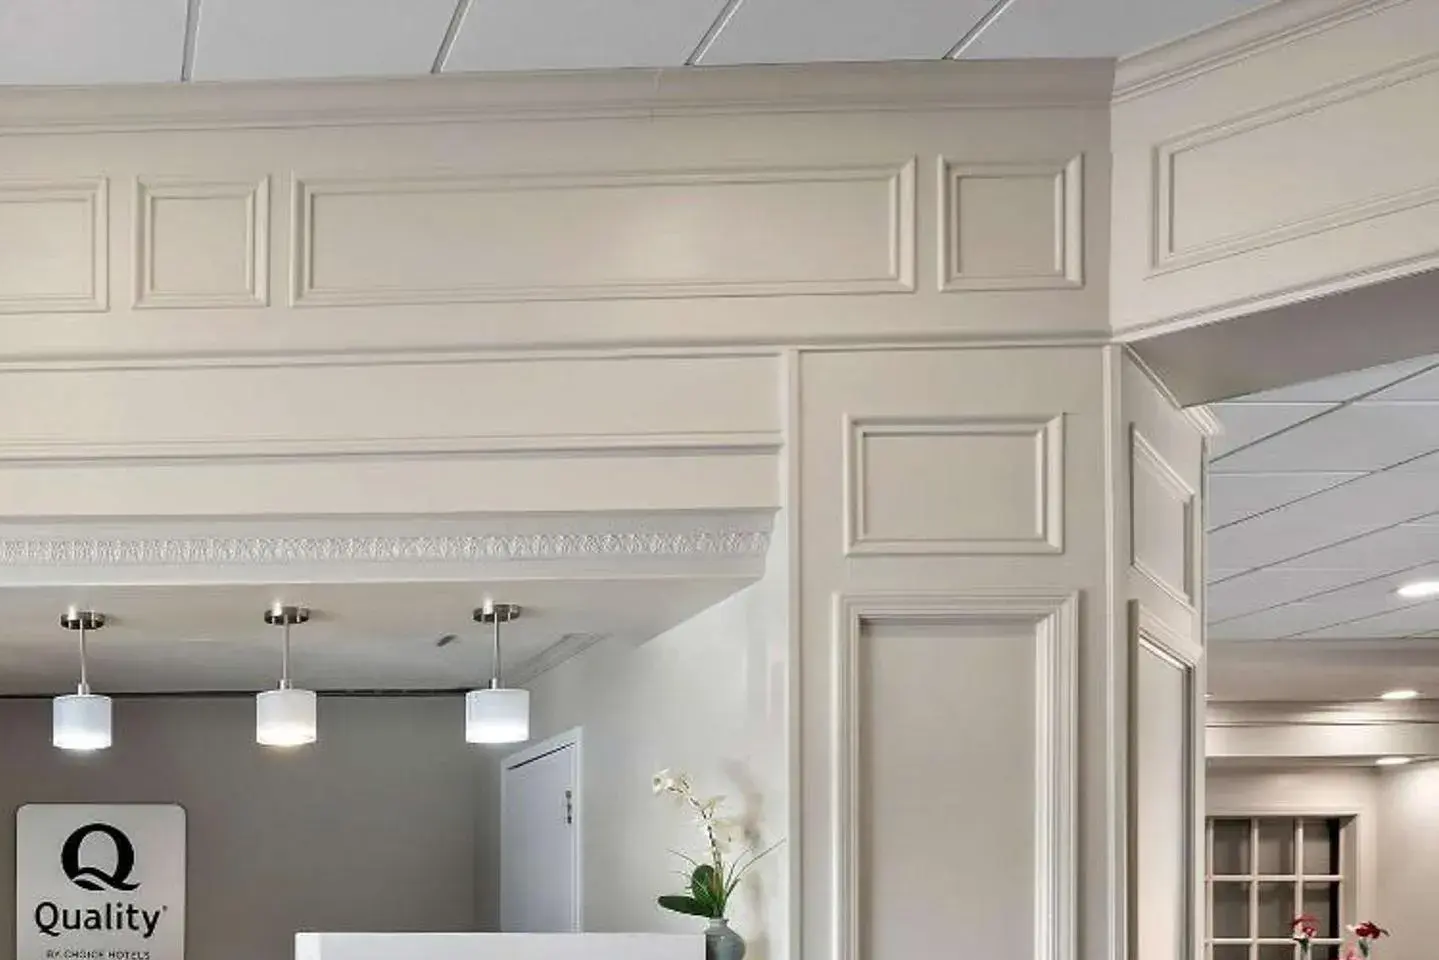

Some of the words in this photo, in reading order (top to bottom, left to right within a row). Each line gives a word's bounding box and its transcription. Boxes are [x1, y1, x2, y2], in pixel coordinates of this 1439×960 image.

[61, 822, 141, 891] Q
[35, 901, 161, 938] Quality
[64, 950, 103, 960] CHOICE
[108, 950, 150, 960] HOTELS
